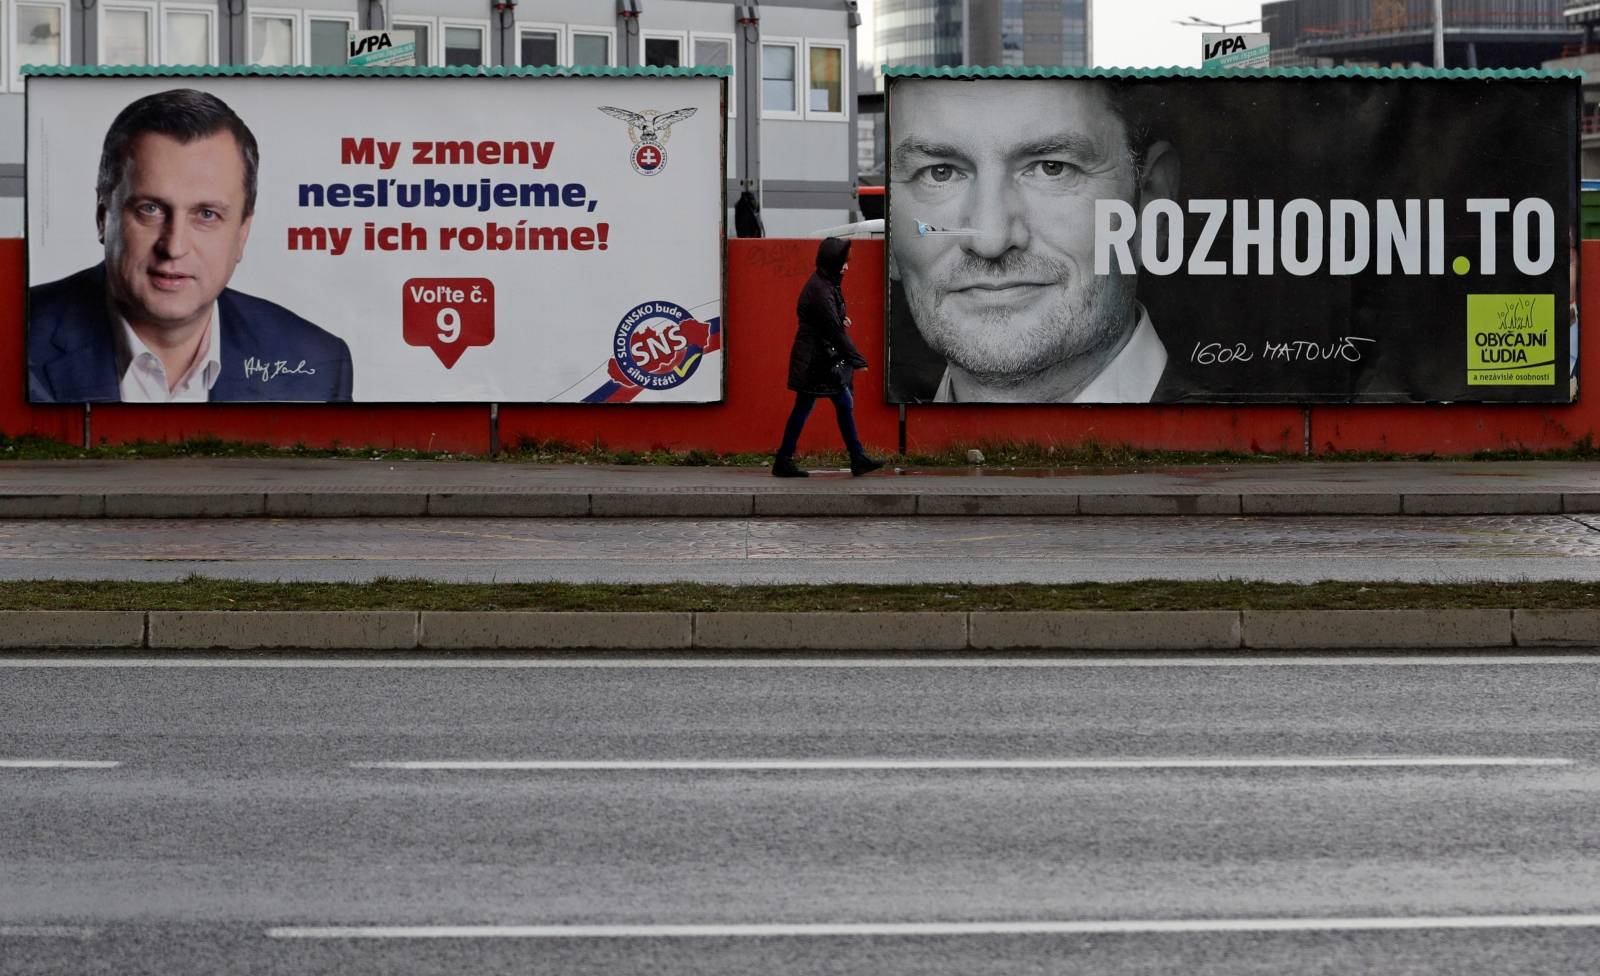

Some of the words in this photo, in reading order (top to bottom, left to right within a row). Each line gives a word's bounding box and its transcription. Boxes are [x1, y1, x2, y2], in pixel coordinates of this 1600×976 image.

[341, 137, 401, 170] My
[412, 140, 555, 170] zmeny
[298, 178, 598, 212] nesľubujeme,
[287, 225, 352, 255] my
[364, 222, 427, 251] ich
[440, 219, 609, 251] robíme!
[1094, 197, 1555, 276] ROZHODNI.TO
[410, 285, 465, 303] Voľte
[470, 285, 488, 303] č.
[436, 307, 461, 344] 9
[616, 304, 653, 359] SLOVENSKO
[655, 303, 683, 319] bude
[1474, 329, 1548, 347] OBYČAJNÍ
[631, 326, 687, 367] SNS
[1191, 341, 1254, 364] IGOR
[1481, 348, 1528, 363] ĽUDIA
[626, 366, 650, 386] silný
[652, 373, 677, 386] štát!
[1515, 372, 1550, 381] osobnosti
